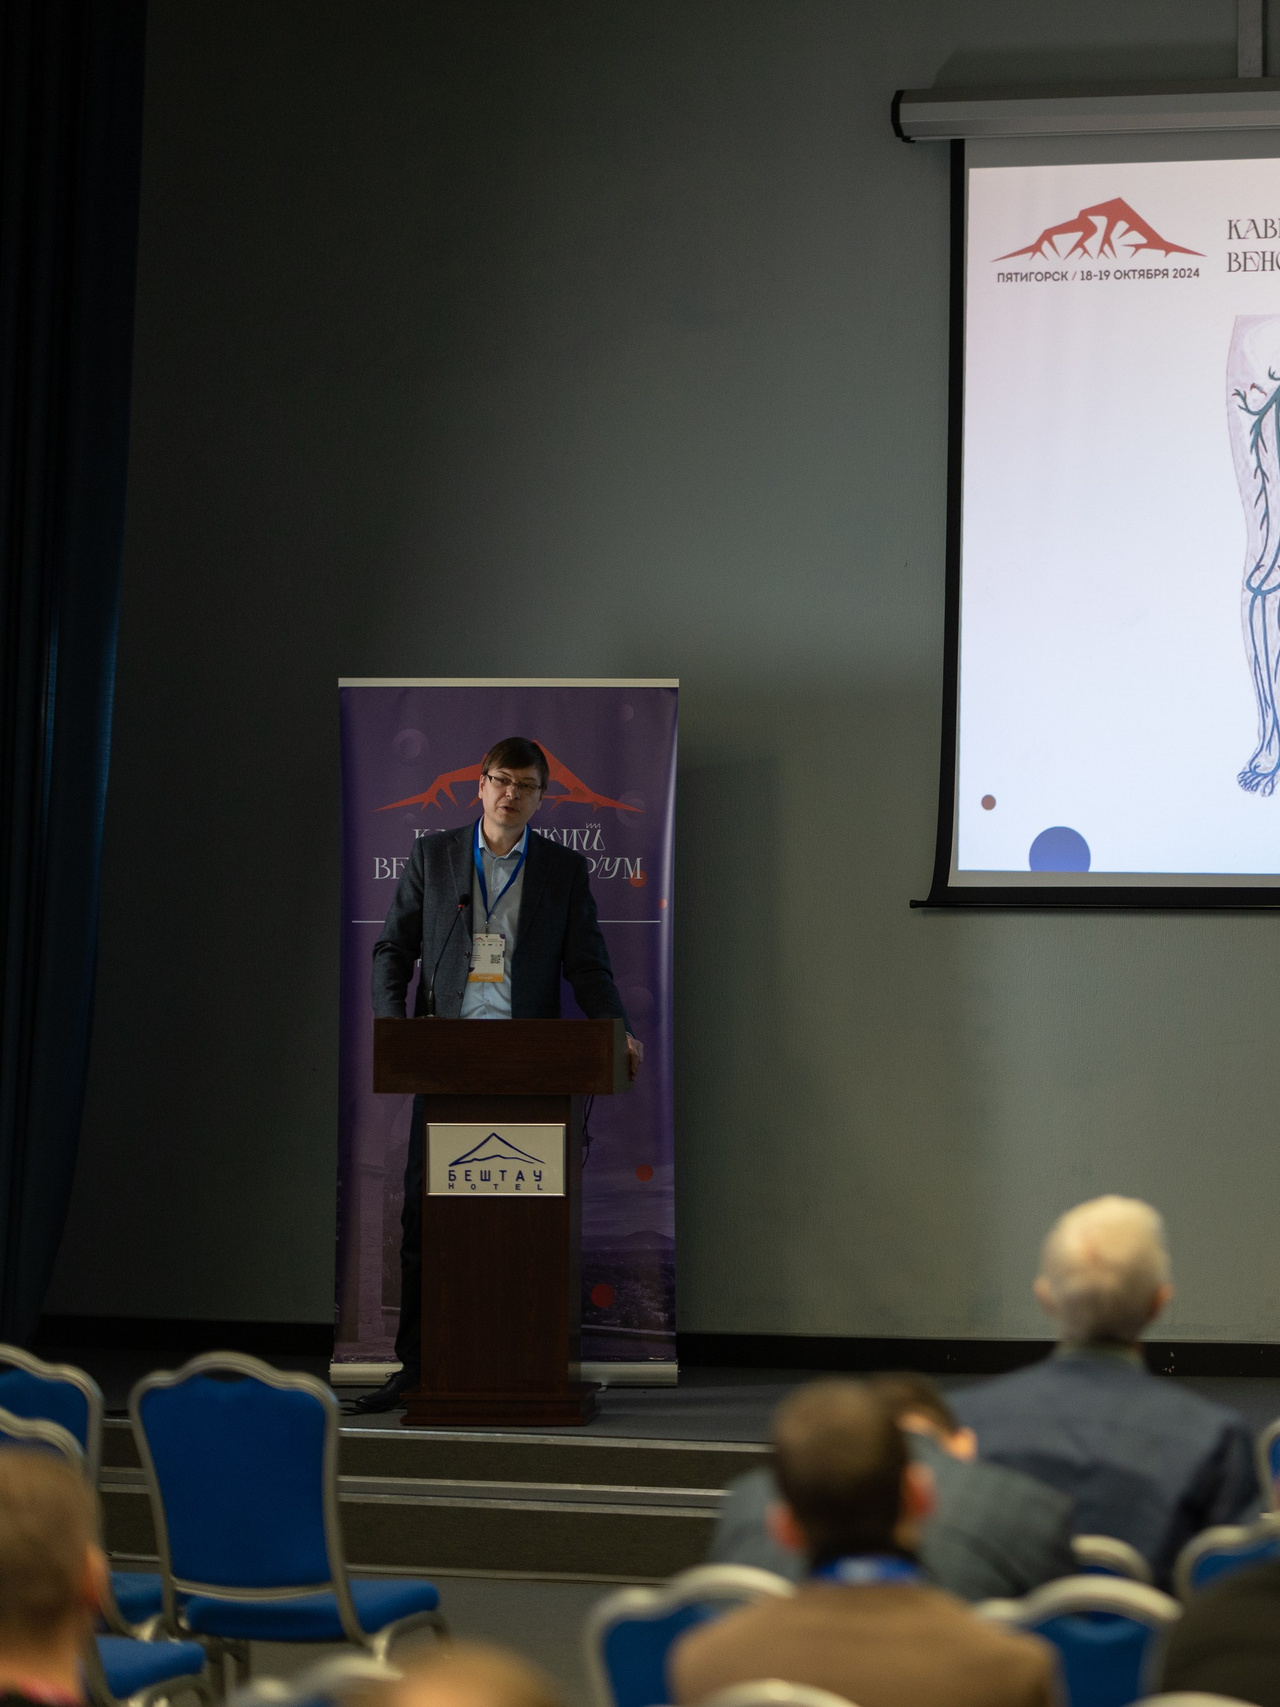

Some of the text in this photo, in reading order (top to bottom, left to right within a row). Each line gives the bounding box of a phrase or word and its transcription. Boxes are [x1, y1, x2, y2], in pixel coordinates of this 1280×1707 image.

[997, 271, 1069, 283] ПЯТИГОРСК
[1080, 270, 1111, 281] 18-19
[1113, 269, 1169, 280] ОКТЯБРЯ
[1172, 267, 1200, 279] 2024
[448, 1170, 543, 1182] БЕШТАУ
[448, 1183, 544, 1191] HOTEL
